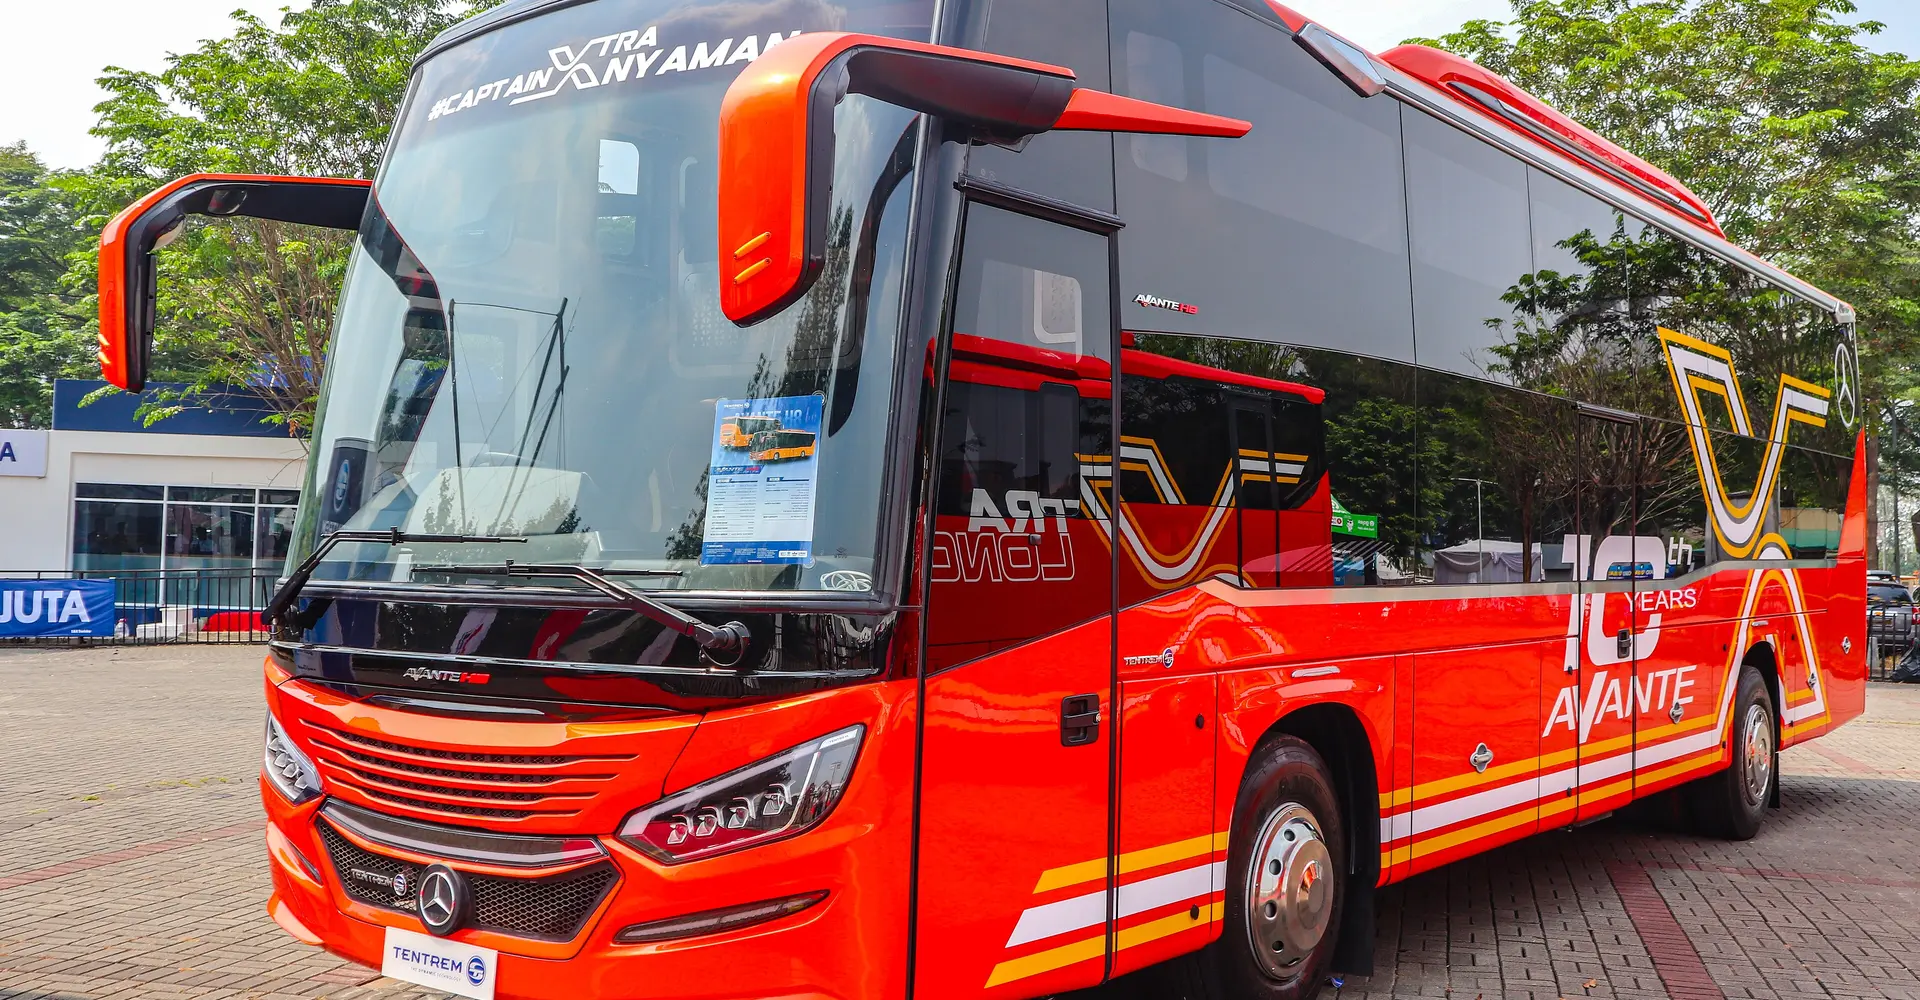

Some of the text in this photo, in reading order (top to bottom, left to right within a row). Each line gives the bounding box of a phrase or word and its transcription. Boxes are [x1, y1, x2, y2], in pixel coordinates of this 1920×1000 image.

[427, 66, 555, 121] #CAPTAIN
[1624, 588, 1697, 612] YEARS
[1541, 665, 1697, 744] AVANTE
[393, 946, 463, 974] TENTREM
